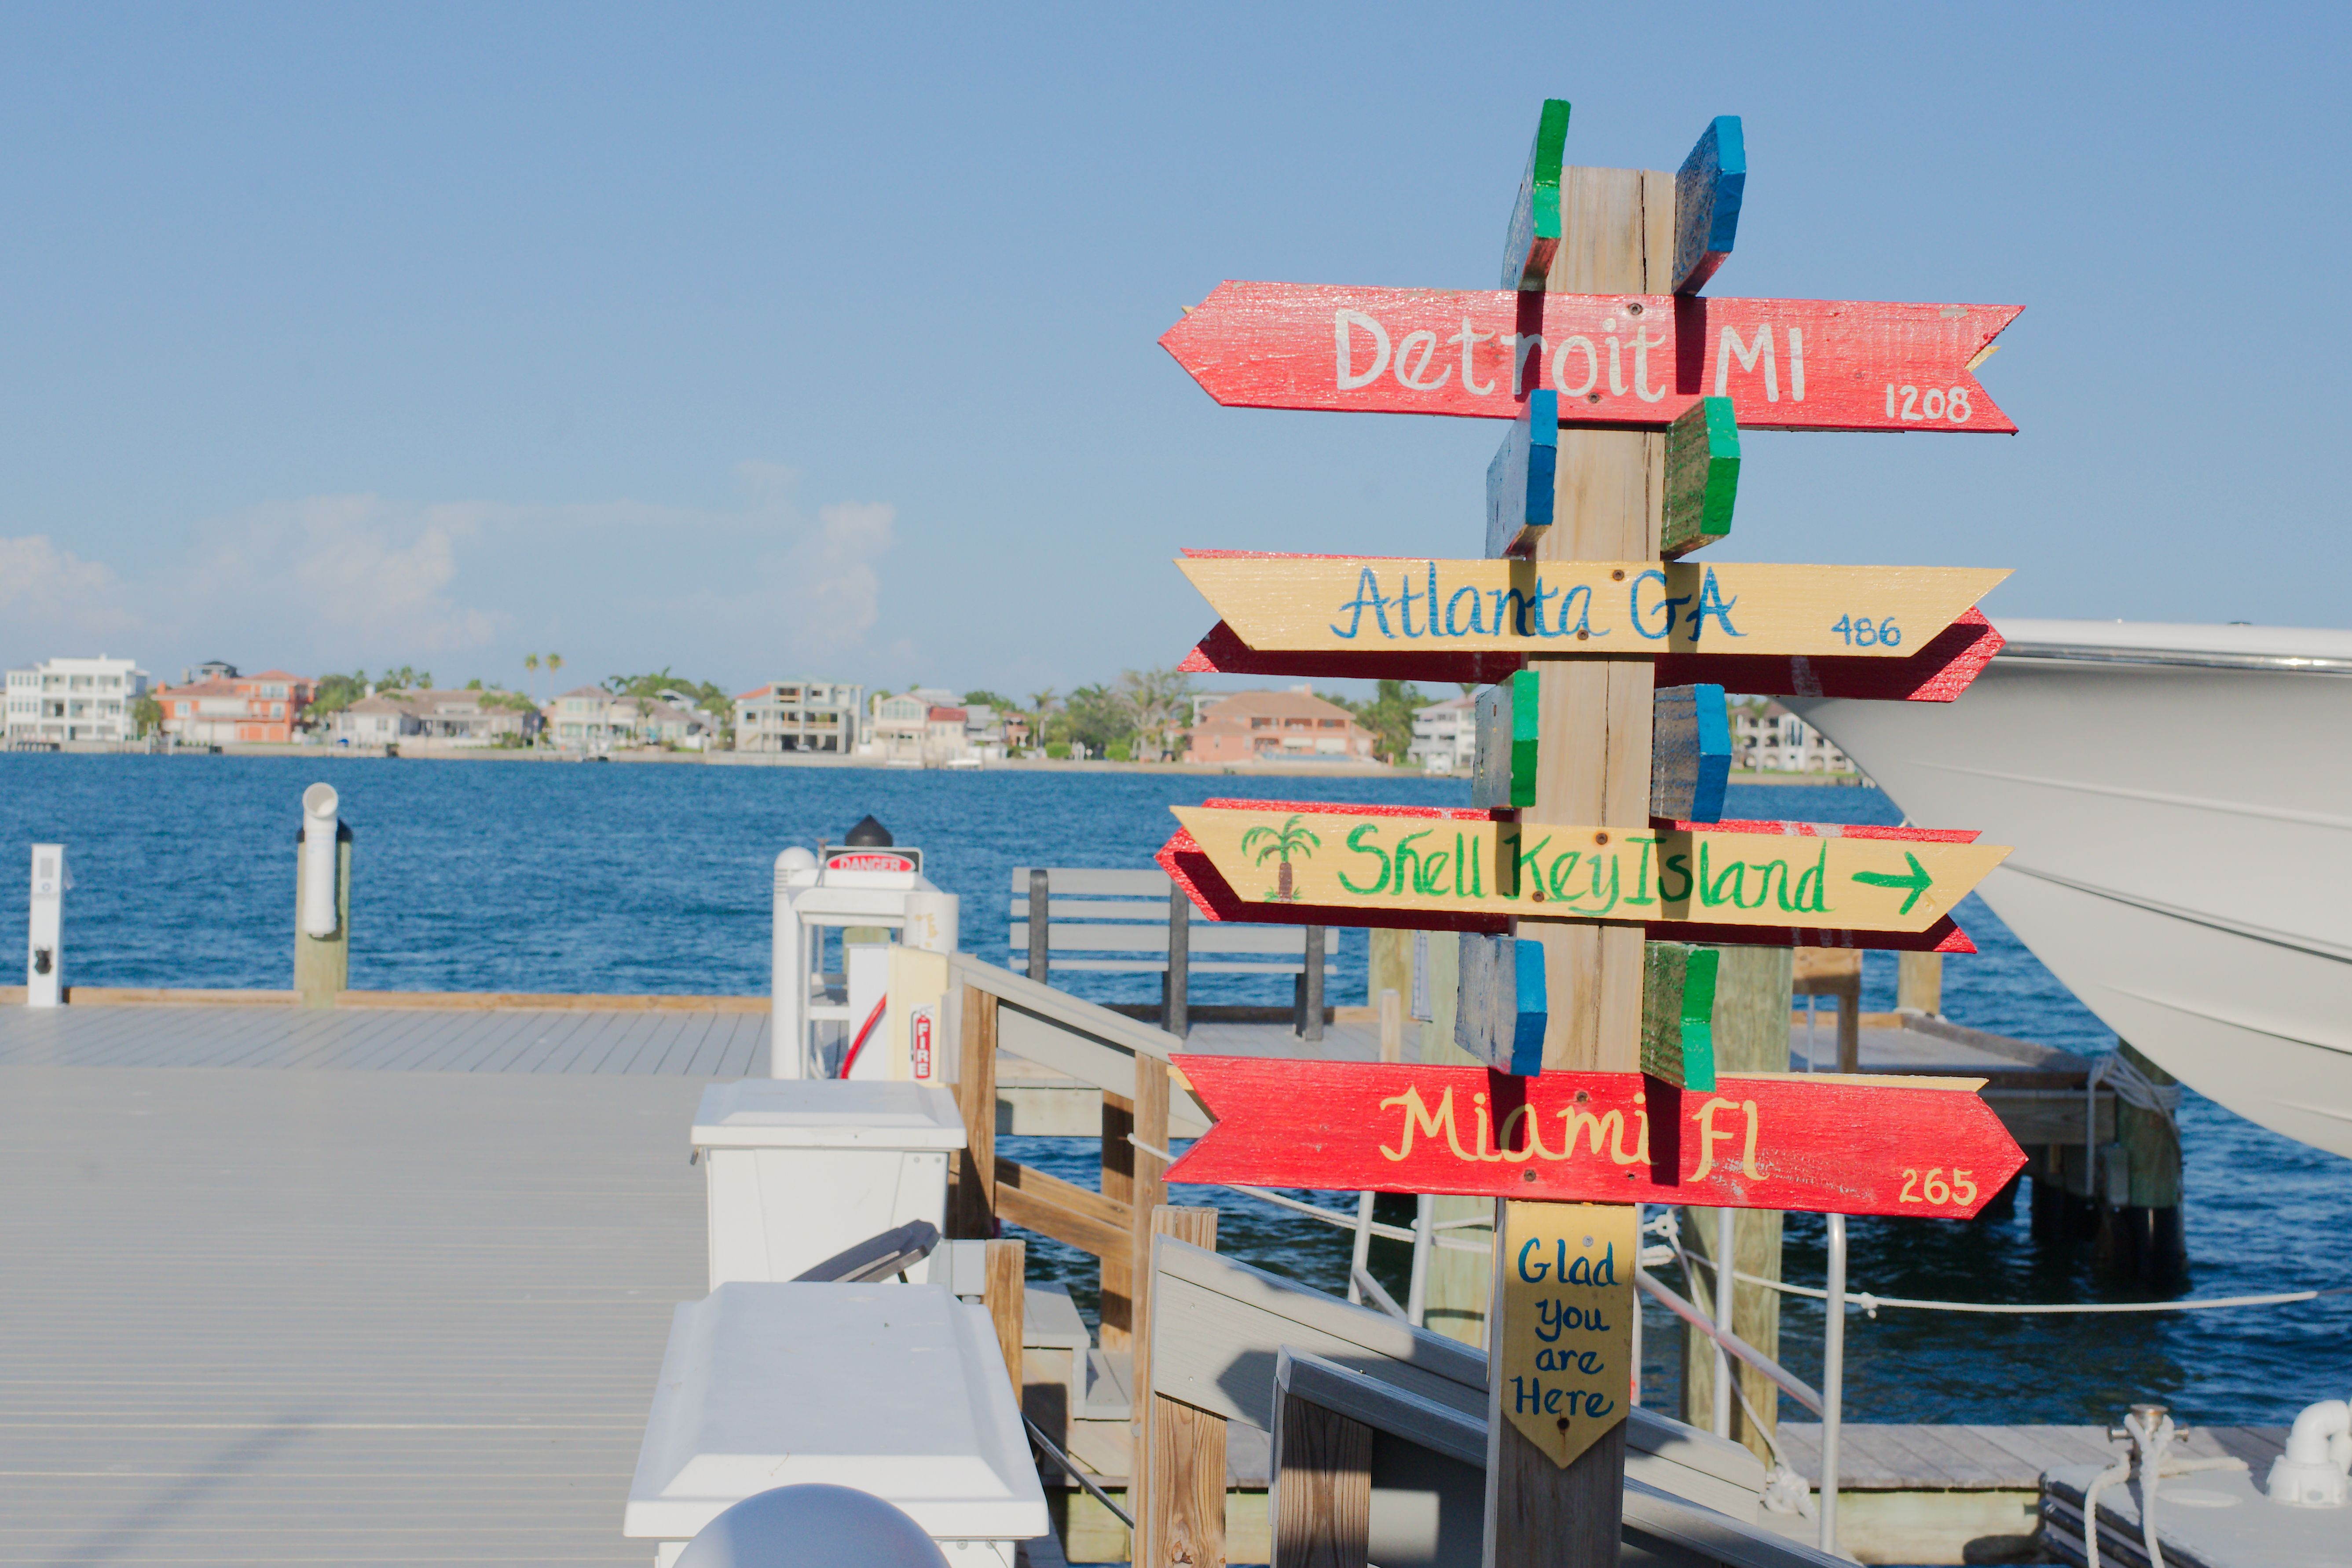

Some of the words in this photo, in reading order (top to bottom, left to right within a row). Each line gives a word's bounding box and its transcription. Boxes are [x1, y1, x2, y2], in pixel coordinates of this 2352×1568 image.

[1335, 308, 1666, 403] Detroit
[1715, 324, 1804, 402] MI
[1885, 383, 1972, 424] 1208
[1330, 561, 1611, 638] Atlanta
[1629, 566, 1748, 641] GA
[1831, 613, 1901, 647] 486
[839, 857, 900, 871] DANGER
[1337, 824, 1487, 899] Shell
[1502, 833, 1619, 917] Key
[1624, 837, 1837, 912] Island
[917, 1023, 929, 1076] FIRE
[1379, 1084, 1658, 1165] Miami
[1899, 1168, 1978, 1205] 265
[1518, 1237, 1622, 1286] Glad
[1535, 1299, 1610, 1342] you
[1536, 1348, 1604, 1375] are
[1509, 1376, 1614, 1418] Here
